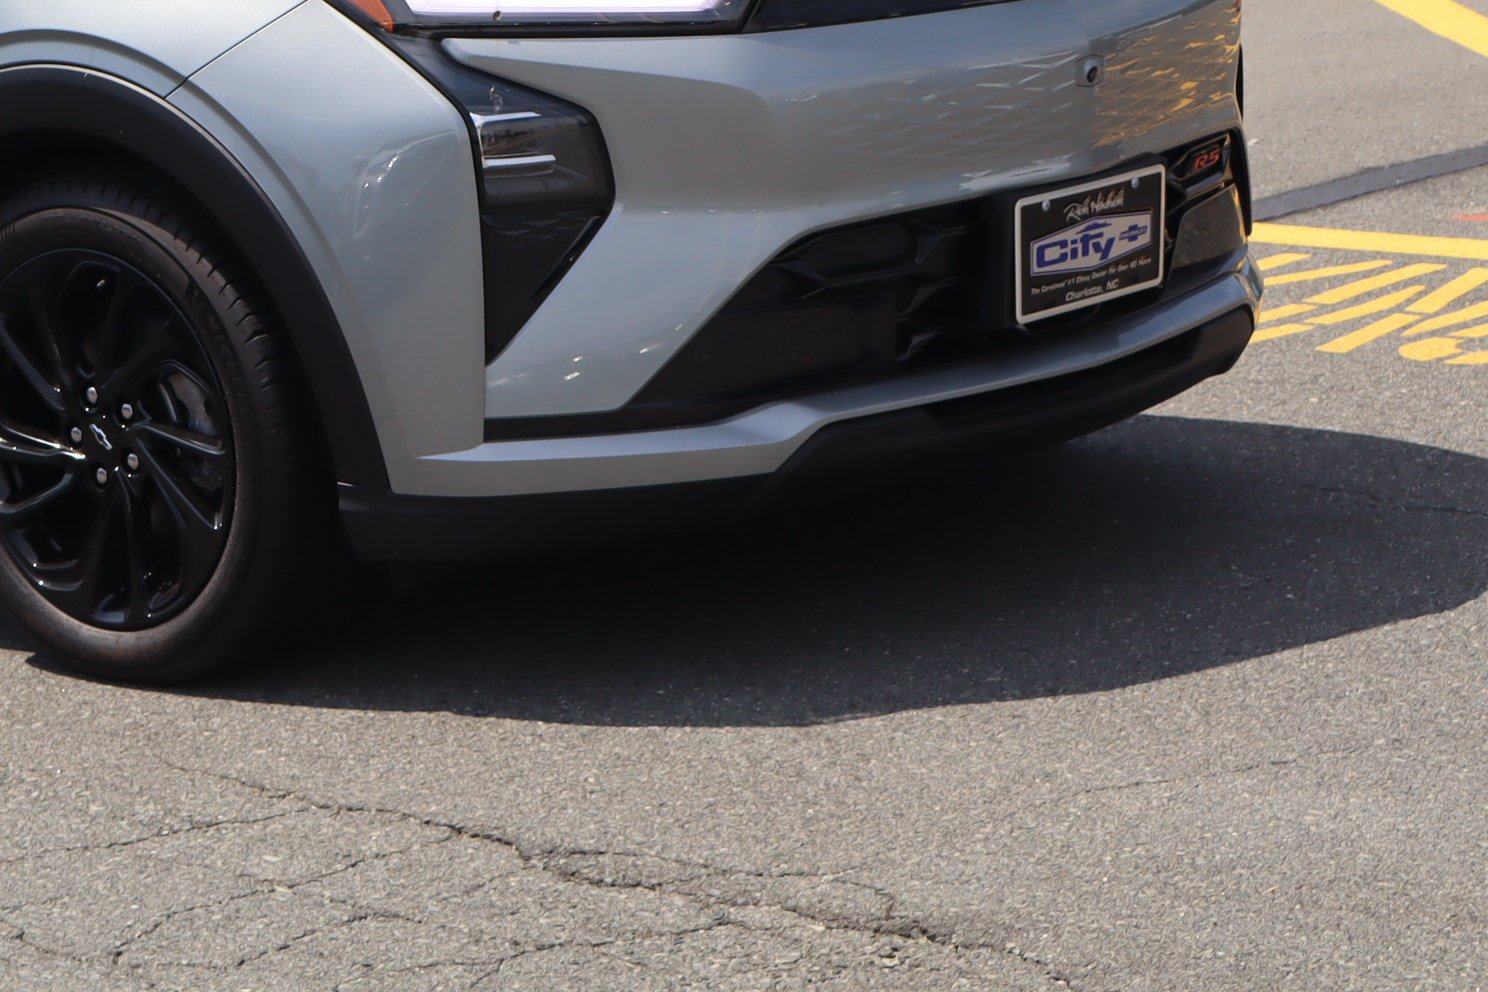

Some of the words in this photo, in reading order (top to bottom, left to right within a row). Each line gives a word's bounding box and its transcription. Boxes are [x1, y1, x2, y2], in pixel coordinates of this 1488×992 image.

[1193, 149, 1221, 172] RS
[1036, 232, 1116, 268] City
[1106, 278, 1120, 291] NC
